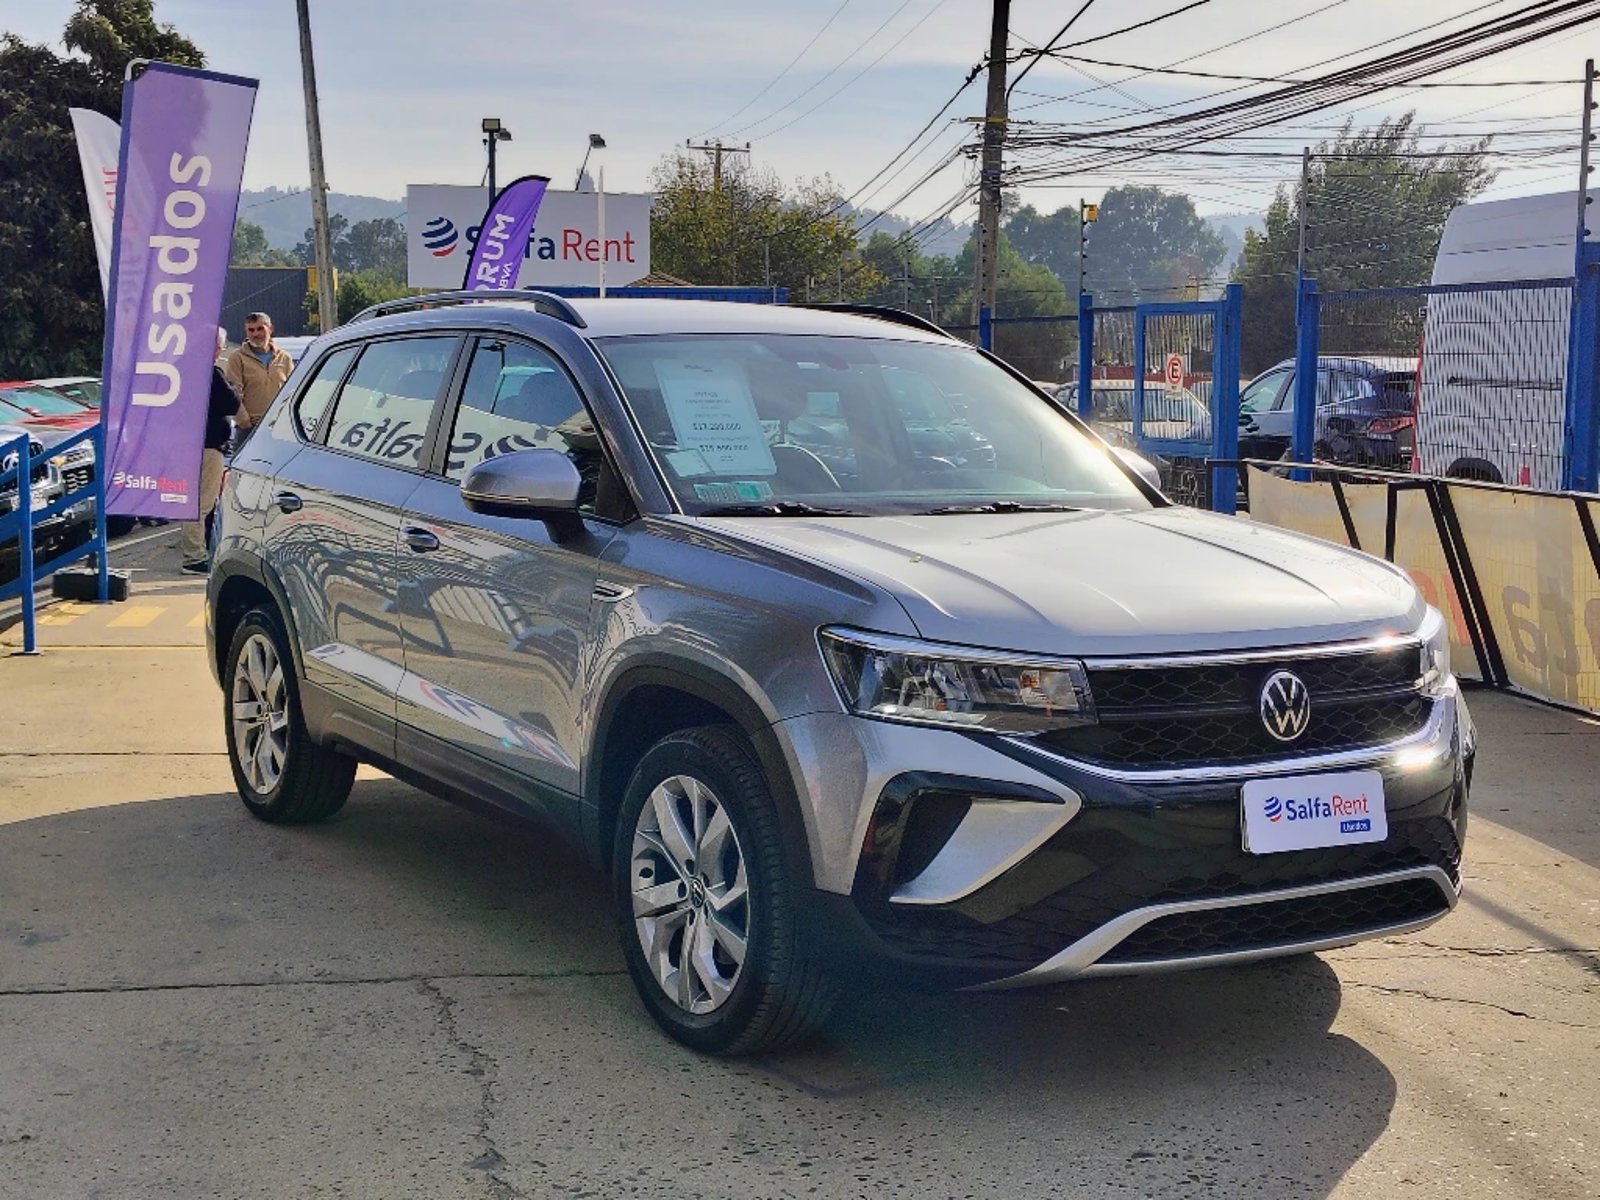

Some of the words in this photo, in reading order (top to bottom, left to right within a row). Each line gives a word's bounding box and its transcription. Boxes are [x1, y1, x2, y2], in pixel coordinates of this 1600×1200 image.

[465, 226, 636, 263] SfaRent
[131, 152, 212, 407] Usados
[498, 262, 513, 291] BVA
[125, 474, 189, 493] SalfaRent
[1285, 793, 1370, 821] SalfaRent
